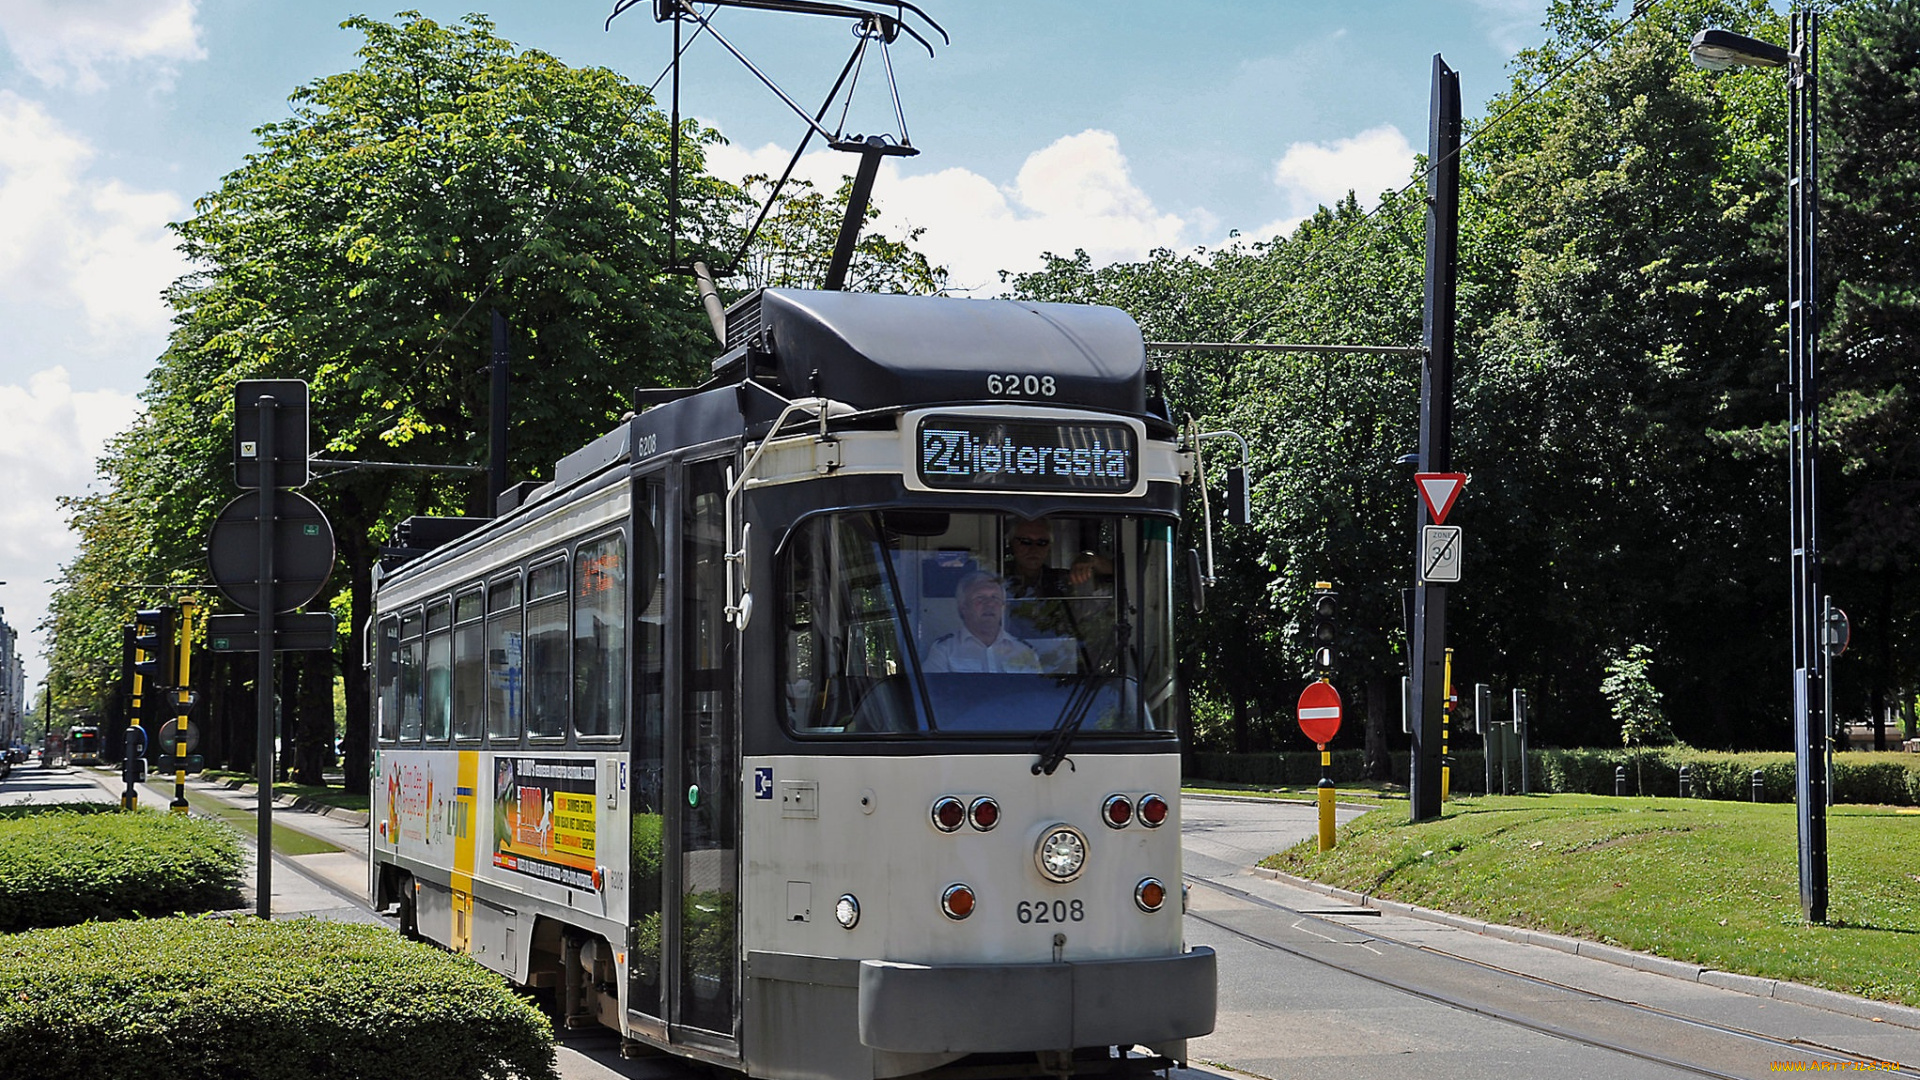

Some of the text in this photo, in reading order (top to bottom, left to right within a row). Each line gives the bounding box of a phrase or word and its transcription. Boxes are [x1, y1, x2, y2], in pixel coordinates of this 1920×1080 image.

[986, 373, 1057, 396] 6208
[638, 433, 657, 457] 6208
[926, 433, 969, 473] 24
[1432, 546, 1452, 561] 30
[1016, 898, 1084, 924] 6208
